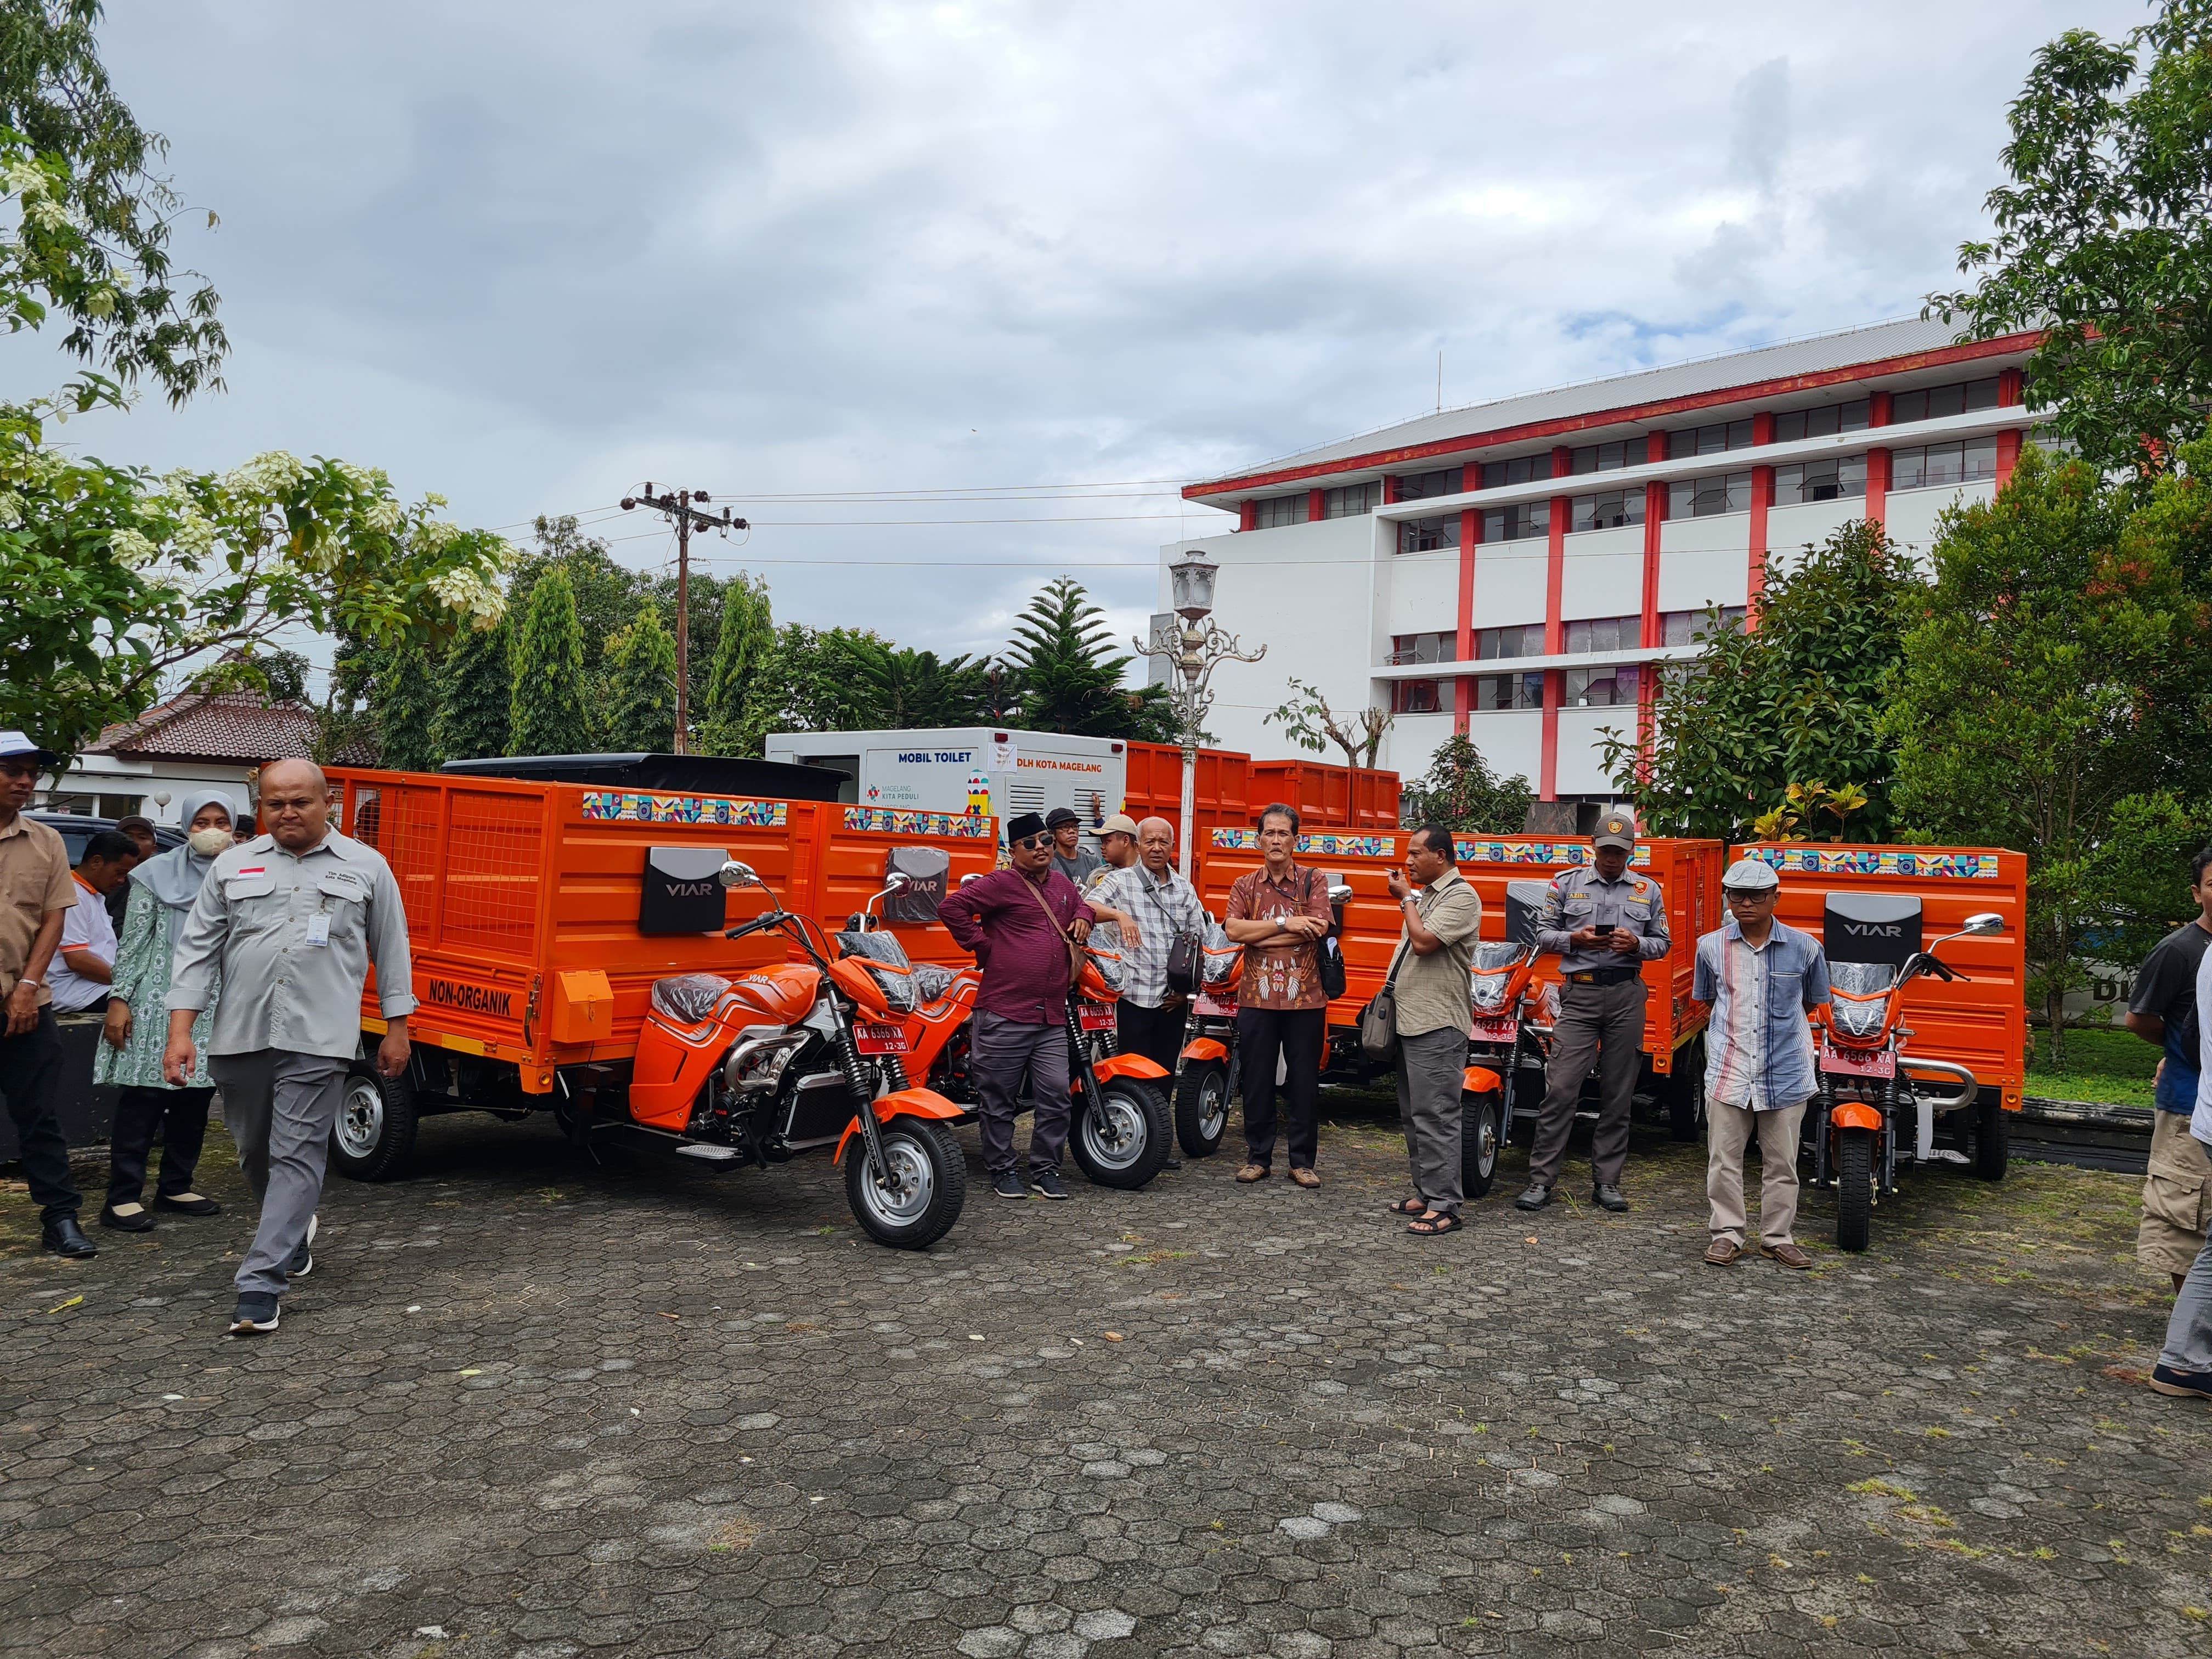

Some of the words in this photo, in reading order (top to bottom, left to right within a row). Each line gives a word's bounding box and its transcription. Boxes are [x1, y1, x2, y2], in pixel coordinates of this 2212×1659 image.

[899, 753, 932, 763] MOBIL
[935, 752, 971, 762] TOILET
[1017, 758, 1033, 768] DLH
[1036, 759, 1057, 769] KOTA
[1059, 761, 1102, 772] MAGELANG
[665, 883, 713, 896] VIAR
[1843, 924, 1902, 938] VIAR
[749, 974, 769, 984] VIAR
[429, 979, 512, 1016] NON-ORGANIK
[1080, 1007, 1088, 1017] AA
[1104, 1006, 1113, 1016] XA
[1475, 1020, 1498, 1030] 6621
[1502, 1021, 1514, 1030] XA
[857, 1027, 868, 1040] AA
[871, 1026, 890, 1039] 6366
[891, 1026, 904, 1039] XA
[1824, 1048, 1838, 1059] AA
[1844, 1050, 1871, 1062] 6566
[1876, 1053, 1892, 1064] XA
